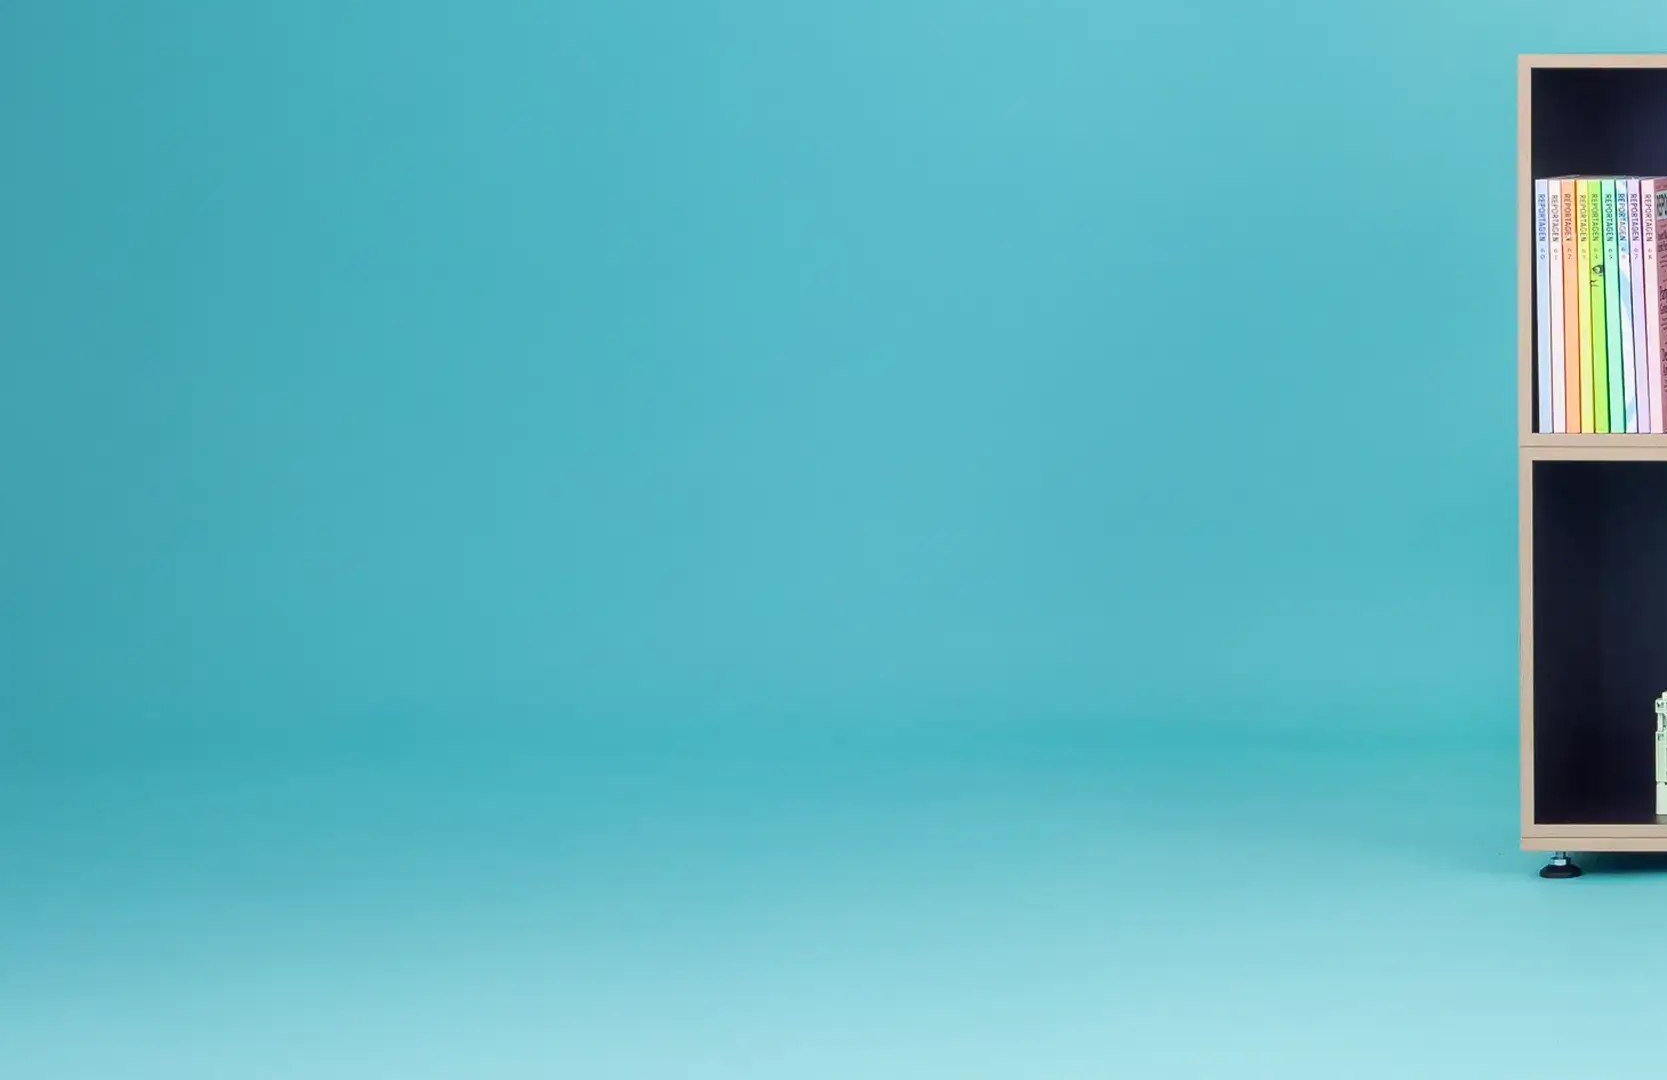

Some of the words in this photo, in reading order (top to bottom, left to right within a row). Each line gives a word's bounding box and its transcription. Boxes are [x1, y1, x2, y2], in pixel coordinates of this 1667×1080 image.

[1538, 194, 1546, 241] REPORTAGEN
[1551, 195, 1560, 242] REPORTAGEN
[1564, 193, 1572, 241] REPORTAGEN
[1579, 195, 1588, 242] REPORTAGEN
[1591, 193, 1600, 241] REPORTAGEN
[1604, 193, 1614, 241] REPORTAGEN
[1618, 193, 1626, 240] REPORTAGEN
[1630, 193, 1639, 241] REPORTAGEN
[1644, 194, 1653, 241] REPORTAGEN
